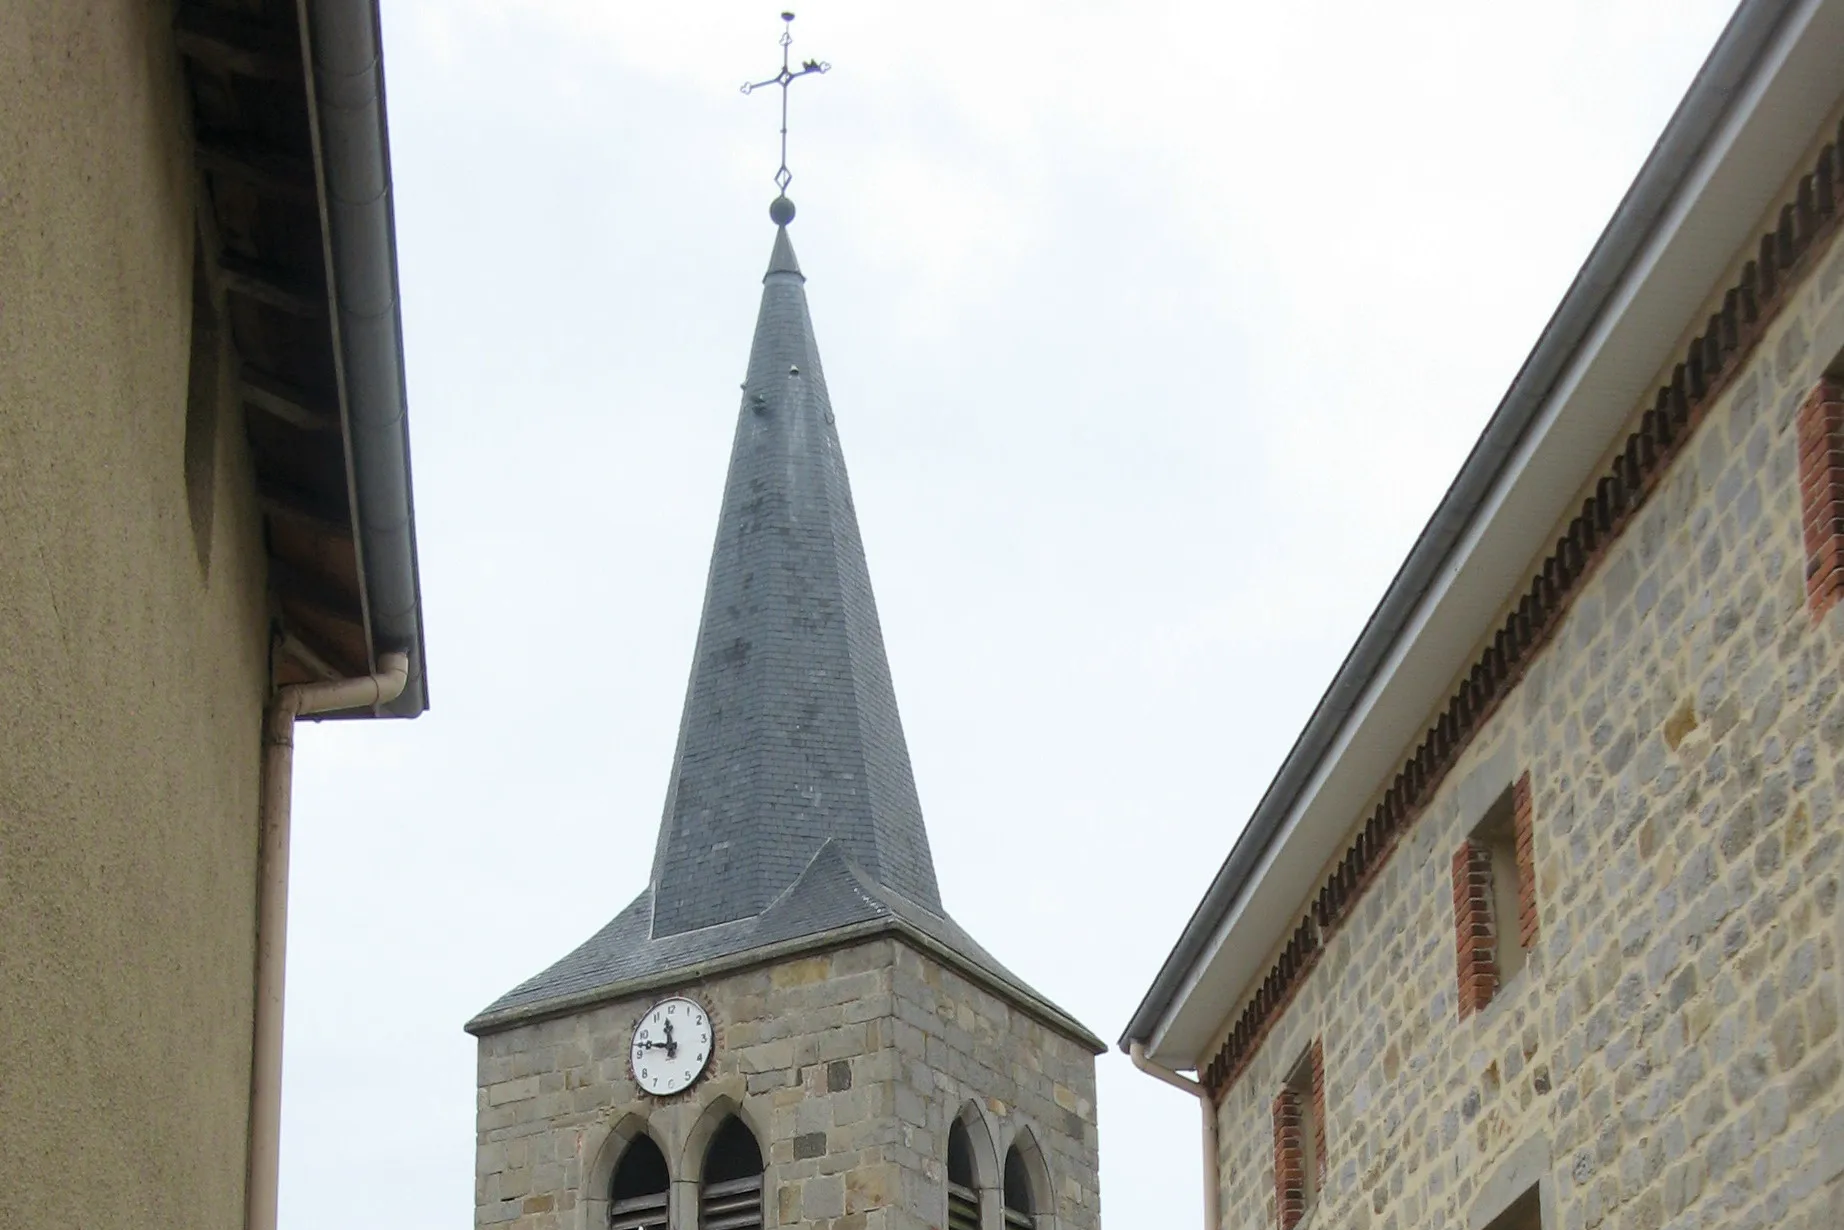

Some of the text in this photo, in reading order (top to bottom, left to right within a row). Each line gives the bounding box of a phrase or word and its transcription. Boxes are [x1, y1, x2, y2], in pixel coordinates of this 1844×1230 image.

[668, 1005, 675, 1014] 12
[653, 1012, 660, 1023] 11
[696, 1014, 702, 1026] 2
[640, 1029, 649, 1040] 10
[700, 1034, 707, 1043] 3
[636, 1050, 643, 1060] 9
[697, 1053, 703, 1062] 4
[641, 1068, 648, 1079] 8
[684, 1070, 691, 1081] 5
[652, 1077, 658, 1088] 7
[667, 1079, 675, 1089] 6
